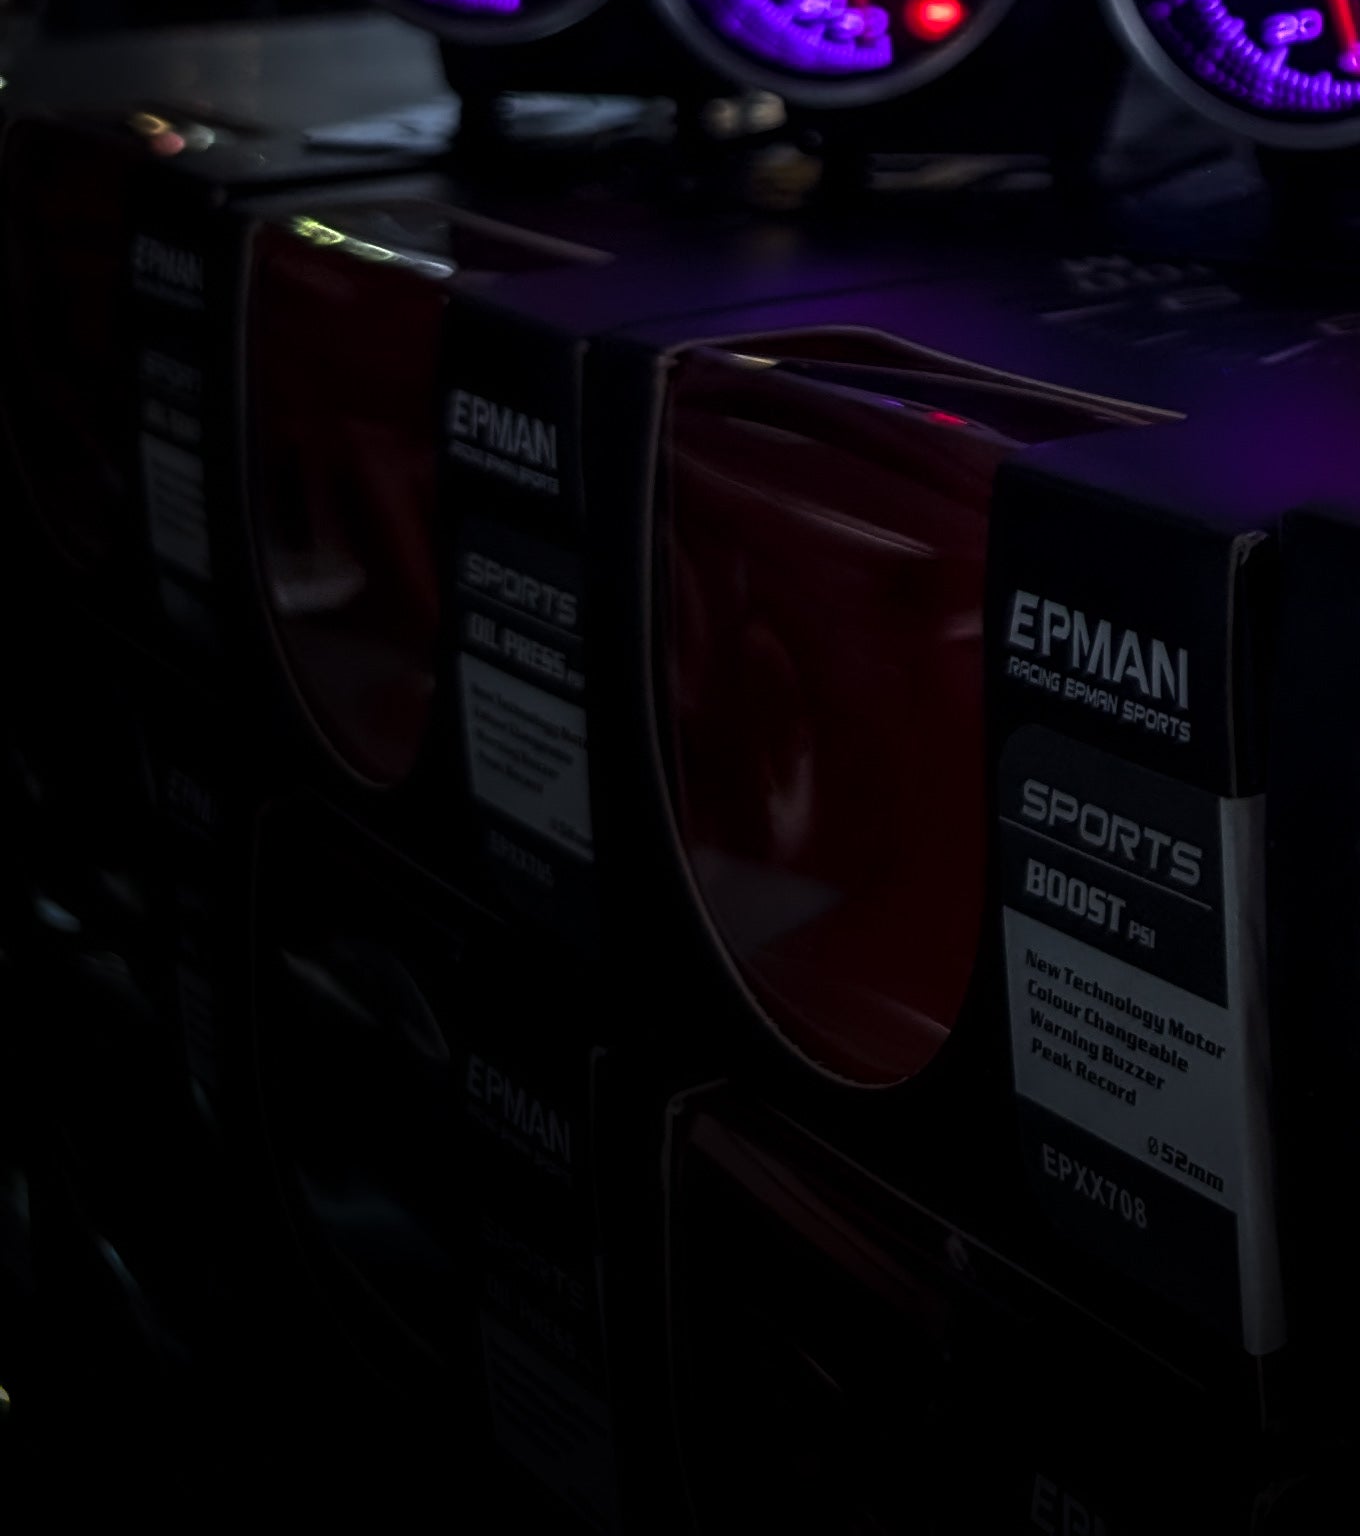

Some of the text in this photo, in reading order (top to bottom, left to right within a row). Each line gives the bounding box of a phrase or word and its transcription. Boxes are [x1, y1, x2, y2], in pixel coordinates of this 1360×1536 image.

[446, 387, 558, 471] EPMAN
[463, 550, 578, 626] SPORTS
[1007, 589, 1190, 710] EPMAN
[1006, 655, 1193, 744] RACING EPMAN SPORTS
[1020, 777, 1204, 886] SPORTS
[1025, 857, 1157, 949] BOOST PSI
[1026, 949, 1226, 1059] New Technology Motor
[1027, 978, 1189, 1073] Colour Changeable
[1030, 1008, 1166, 1090] Warning Buzzer
[466, 1051, 573, 1164] EPMAN
[1032, 1037, 1137, 1106] Peak Record
[1040, 1141, 1152, 1230] EPXX708
